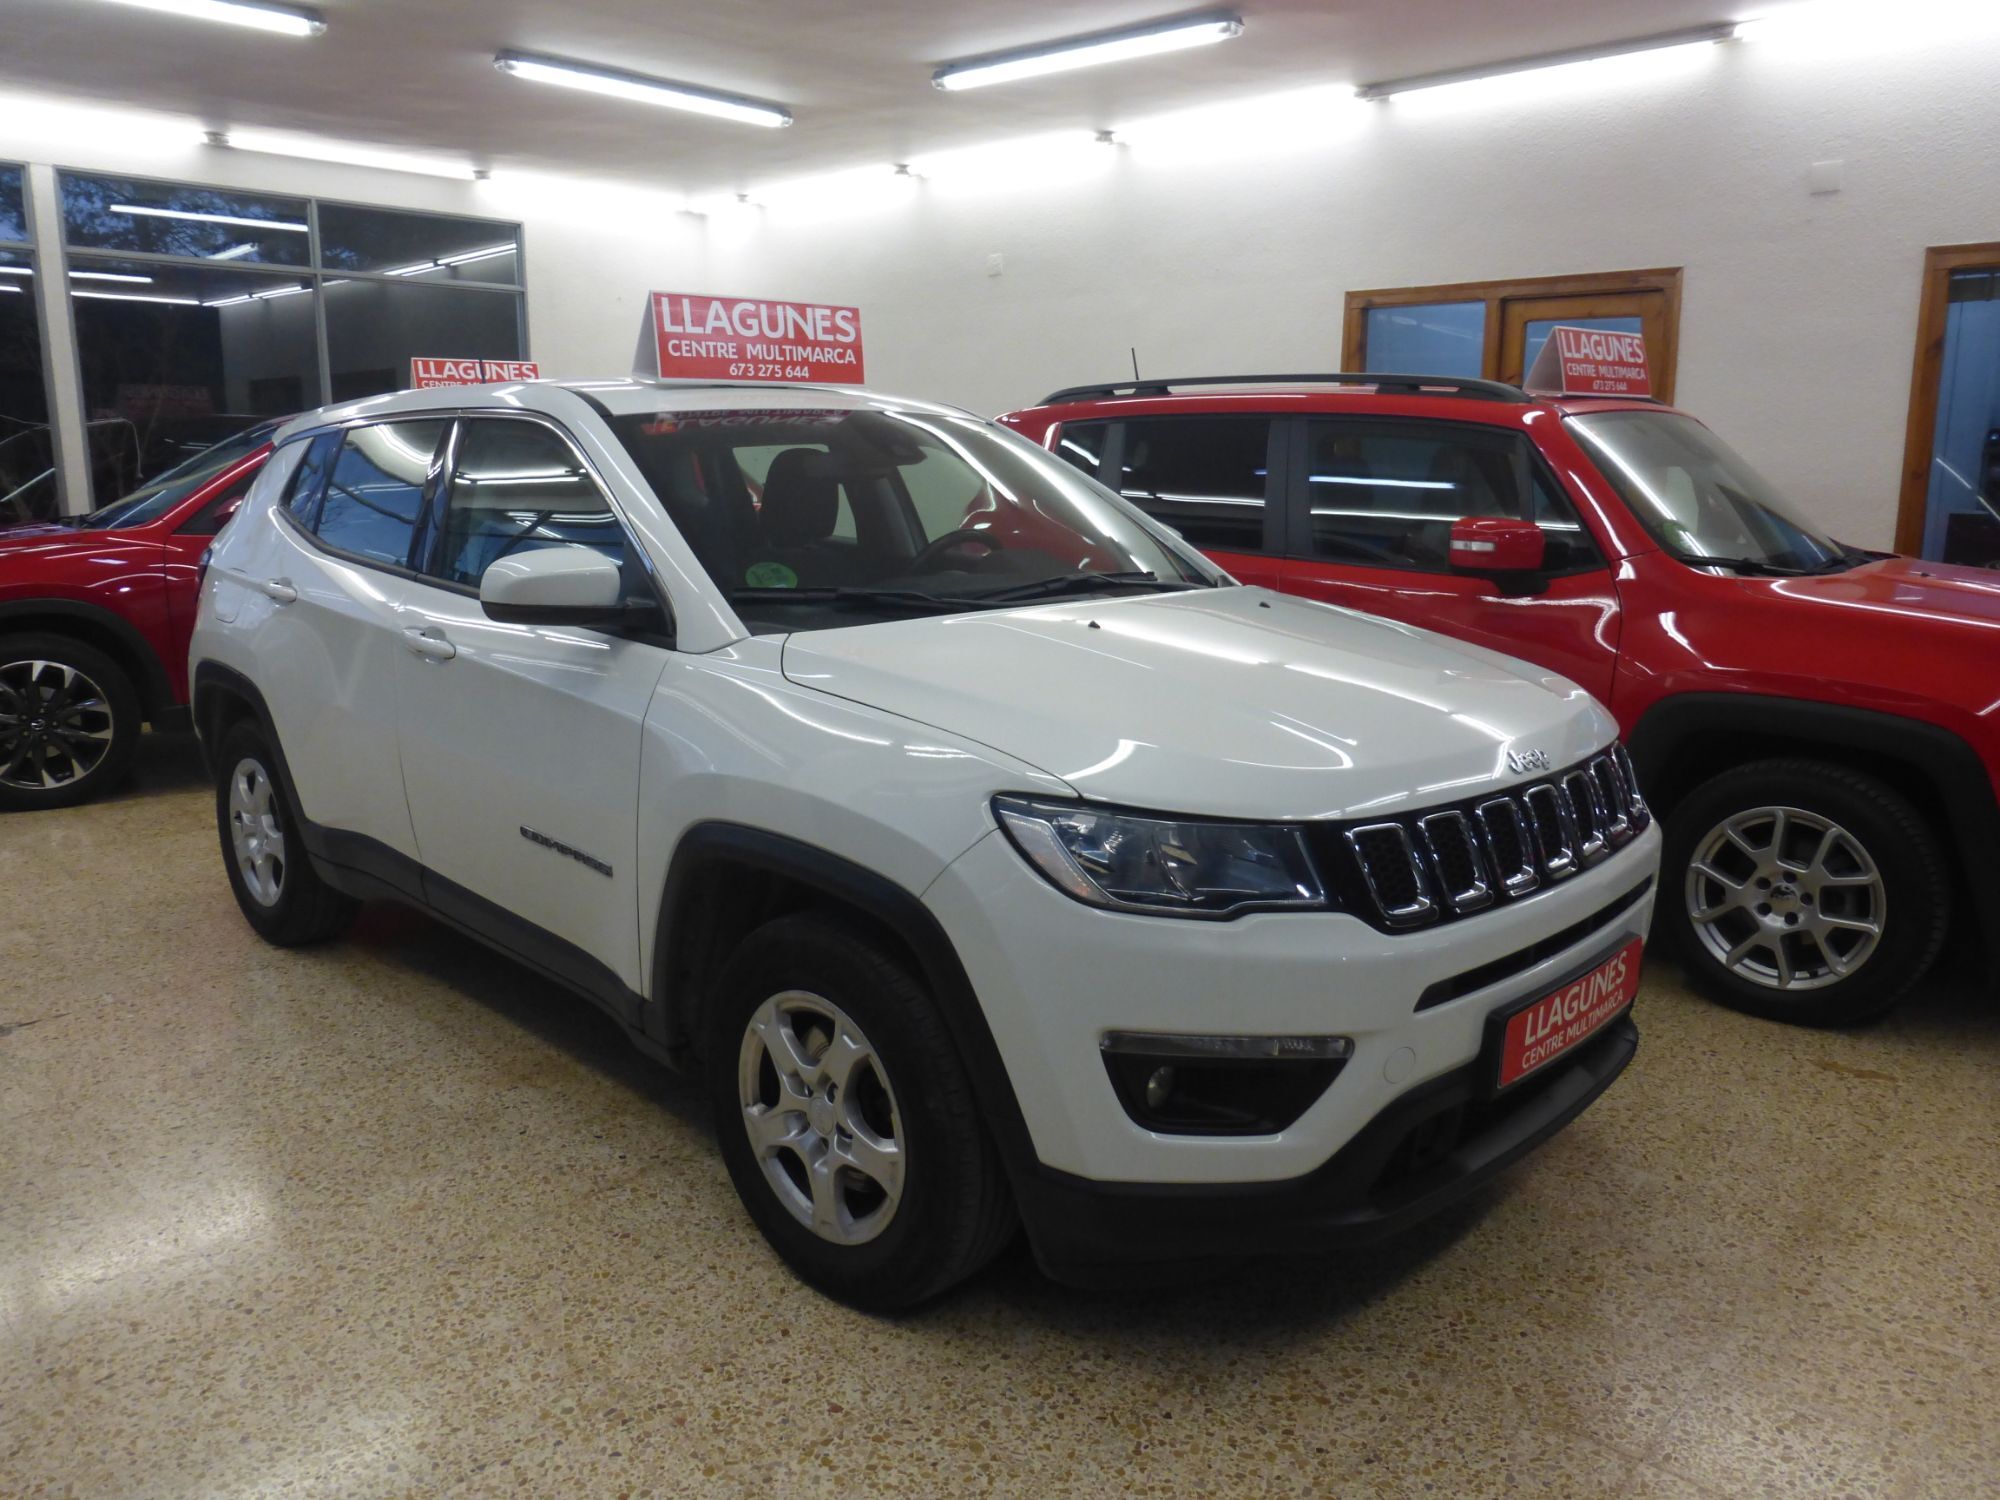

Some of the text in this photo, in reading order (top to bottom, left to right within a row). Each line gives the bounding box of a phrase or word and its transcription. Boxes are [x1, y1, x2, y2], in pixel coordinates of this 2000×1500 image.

[660, 296, 857, 343] LLAGUNES
[667, 339, 857, 365] CENTRE MULTIMARCA
[1561, 331, 1645, 363] LLAGUNES
[417, 360, 536, 381] LLAGUNES
[729, 362, 810, 379] 673 275 644
[1567, 363, 1646, 380] CENTRE MULTIMARCA
[1507, 749, 1550, 775] Jeep
[1524, 951, 1627, 1047] LLAGUNES
[1521, 988, 1624, 1069] CENTRE MULTIMARCA
